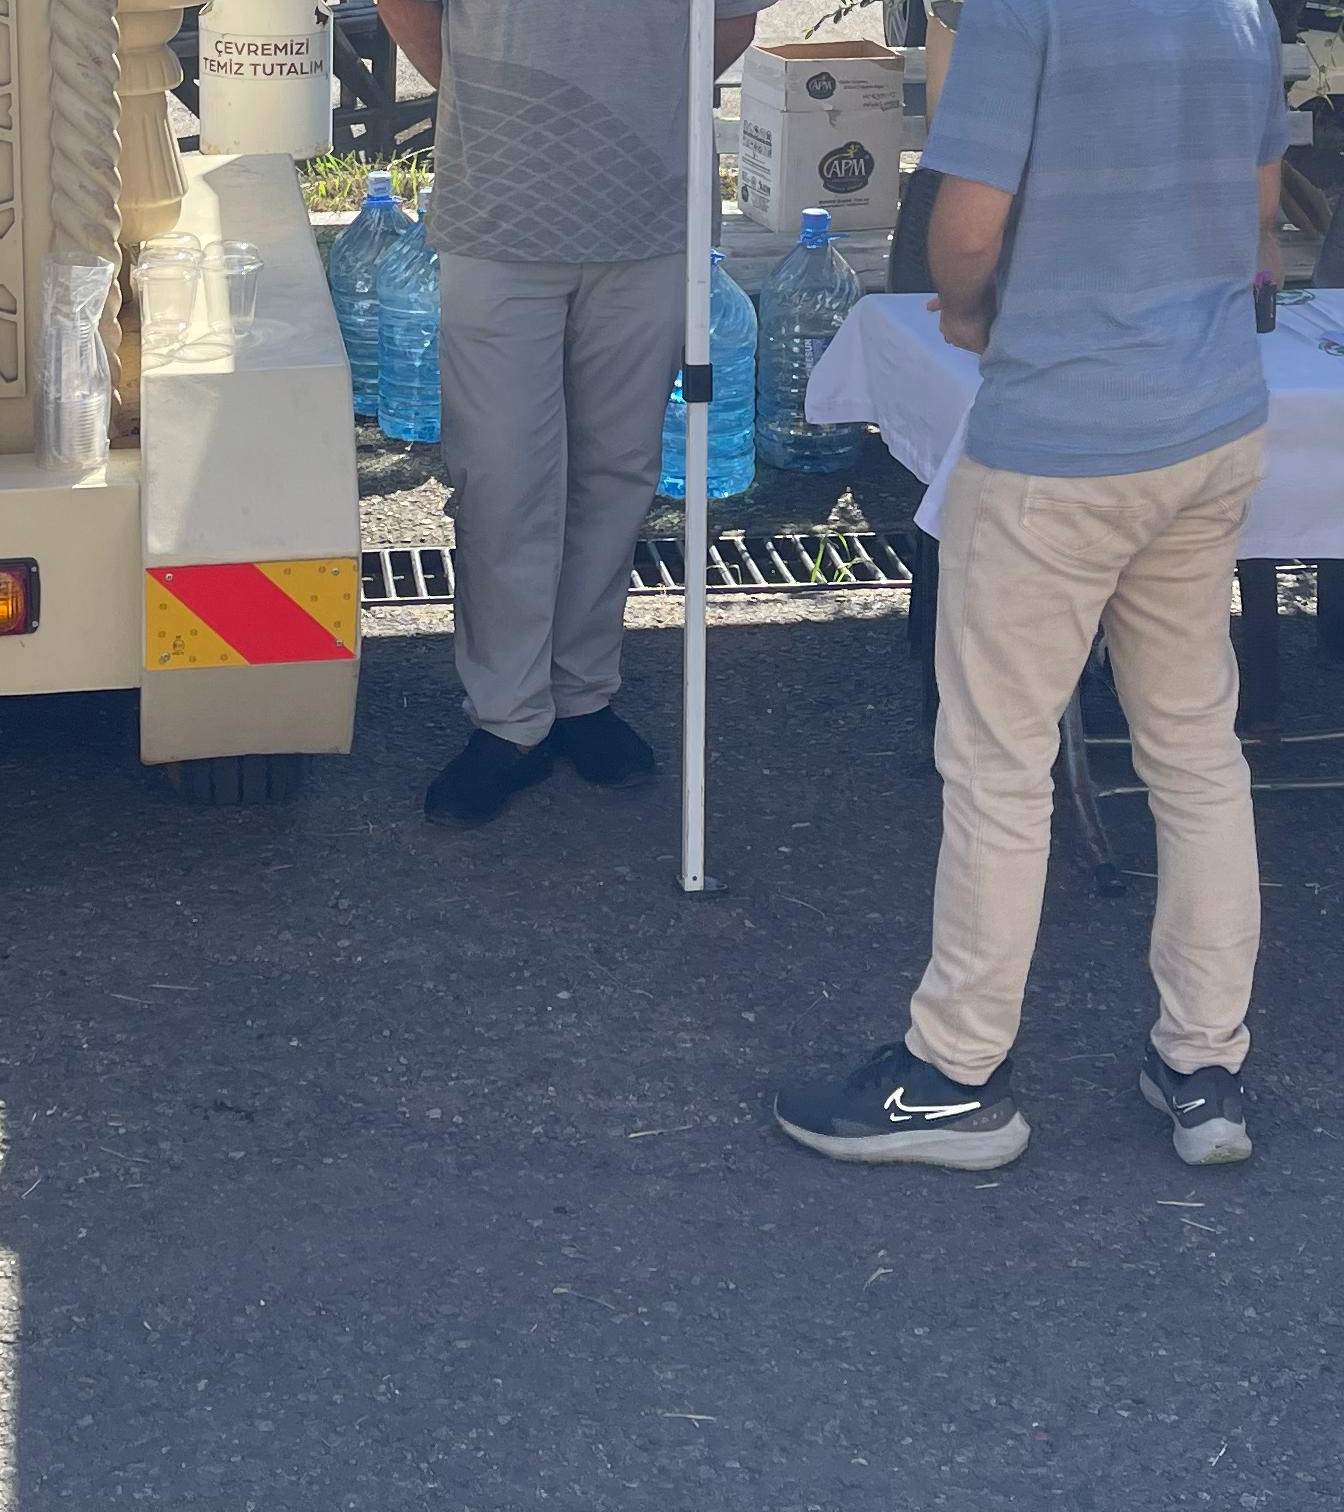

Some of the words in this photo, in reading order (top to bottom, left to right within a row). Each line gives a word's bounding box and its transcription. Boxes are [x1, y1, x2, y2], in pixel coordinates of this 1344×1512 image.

[215, 38, 309, 57] ÇEVREMİZİ
[203, 57, 244, 76] TEMİZ
[250, 59, 323, 76] TUTALIM
[826, 159, 866, 177] APM
